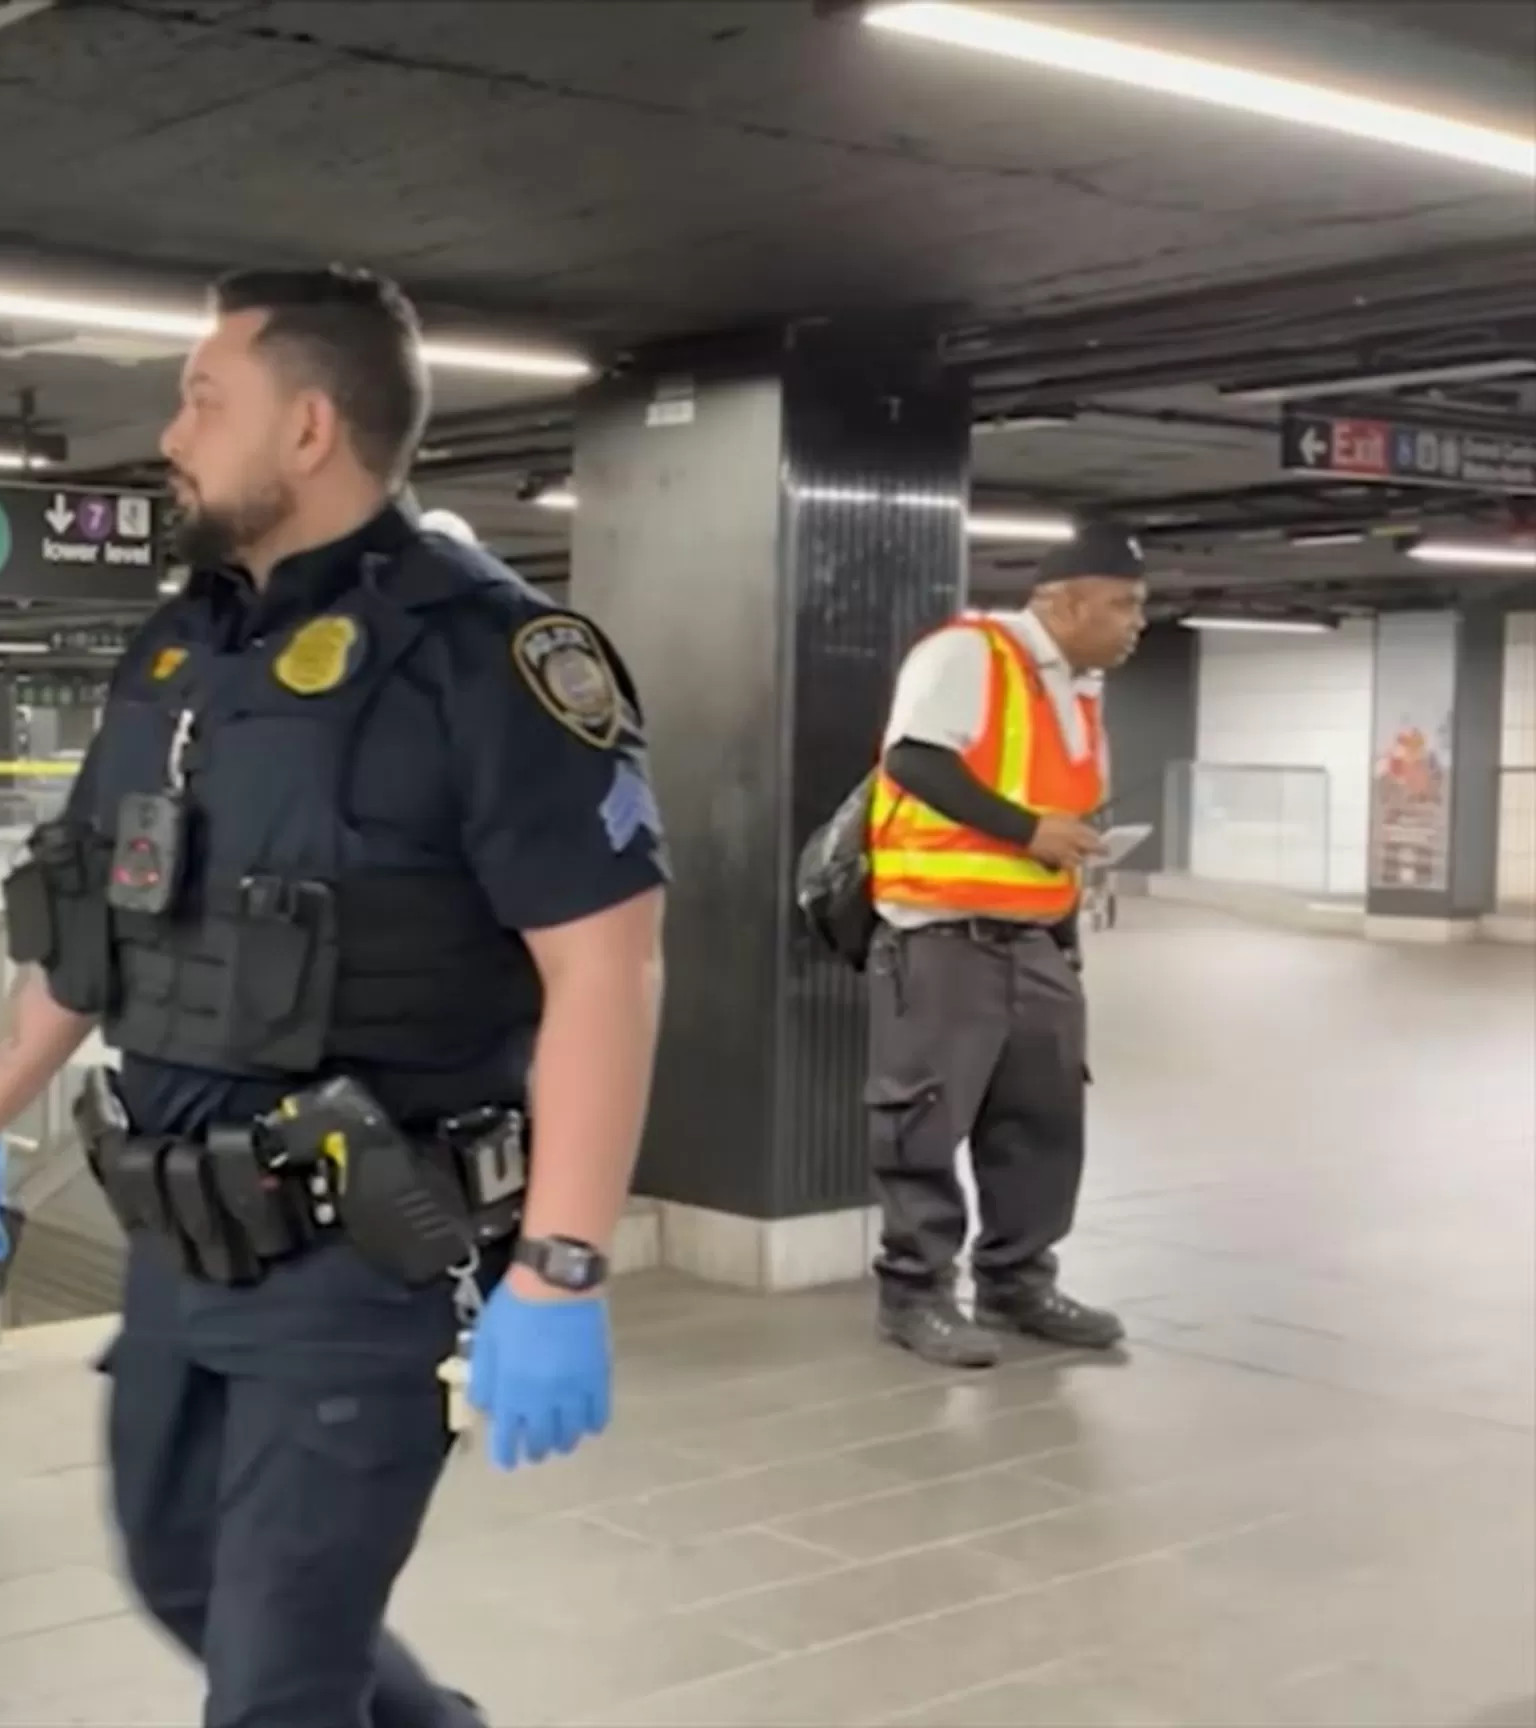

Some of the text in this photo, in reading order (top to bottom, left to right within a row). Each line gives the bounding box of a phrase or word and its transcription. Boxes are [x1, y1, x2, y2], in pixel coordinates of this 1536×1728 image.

[1333, 422, 1385, 467] Exit
[86, 502, 106, 531] 7
[42, 537, 152, 566] lower level
